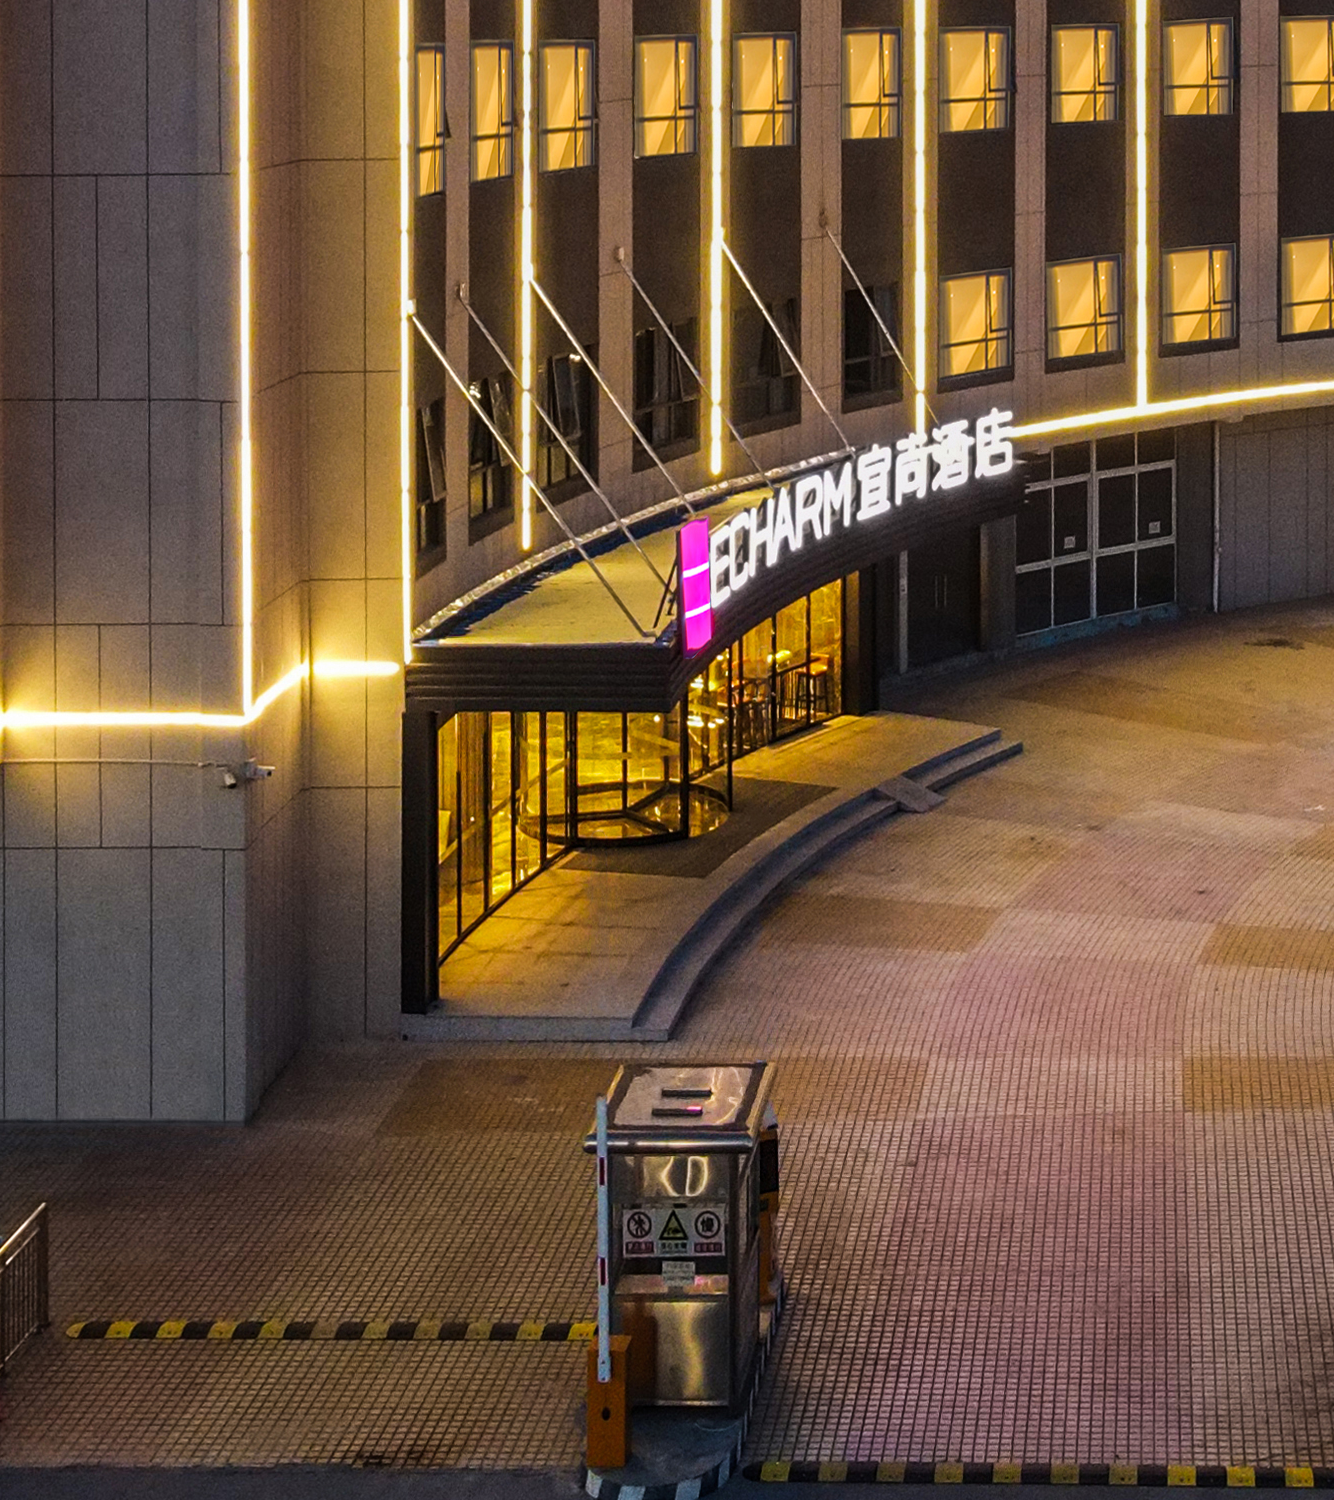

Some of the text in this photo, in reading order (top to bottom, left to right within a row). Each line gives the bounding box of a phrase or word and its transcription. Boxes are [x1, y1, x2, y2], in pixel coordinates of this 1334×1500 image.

[710, 408, 1013, 609] ECHARM 宜尚酒店
